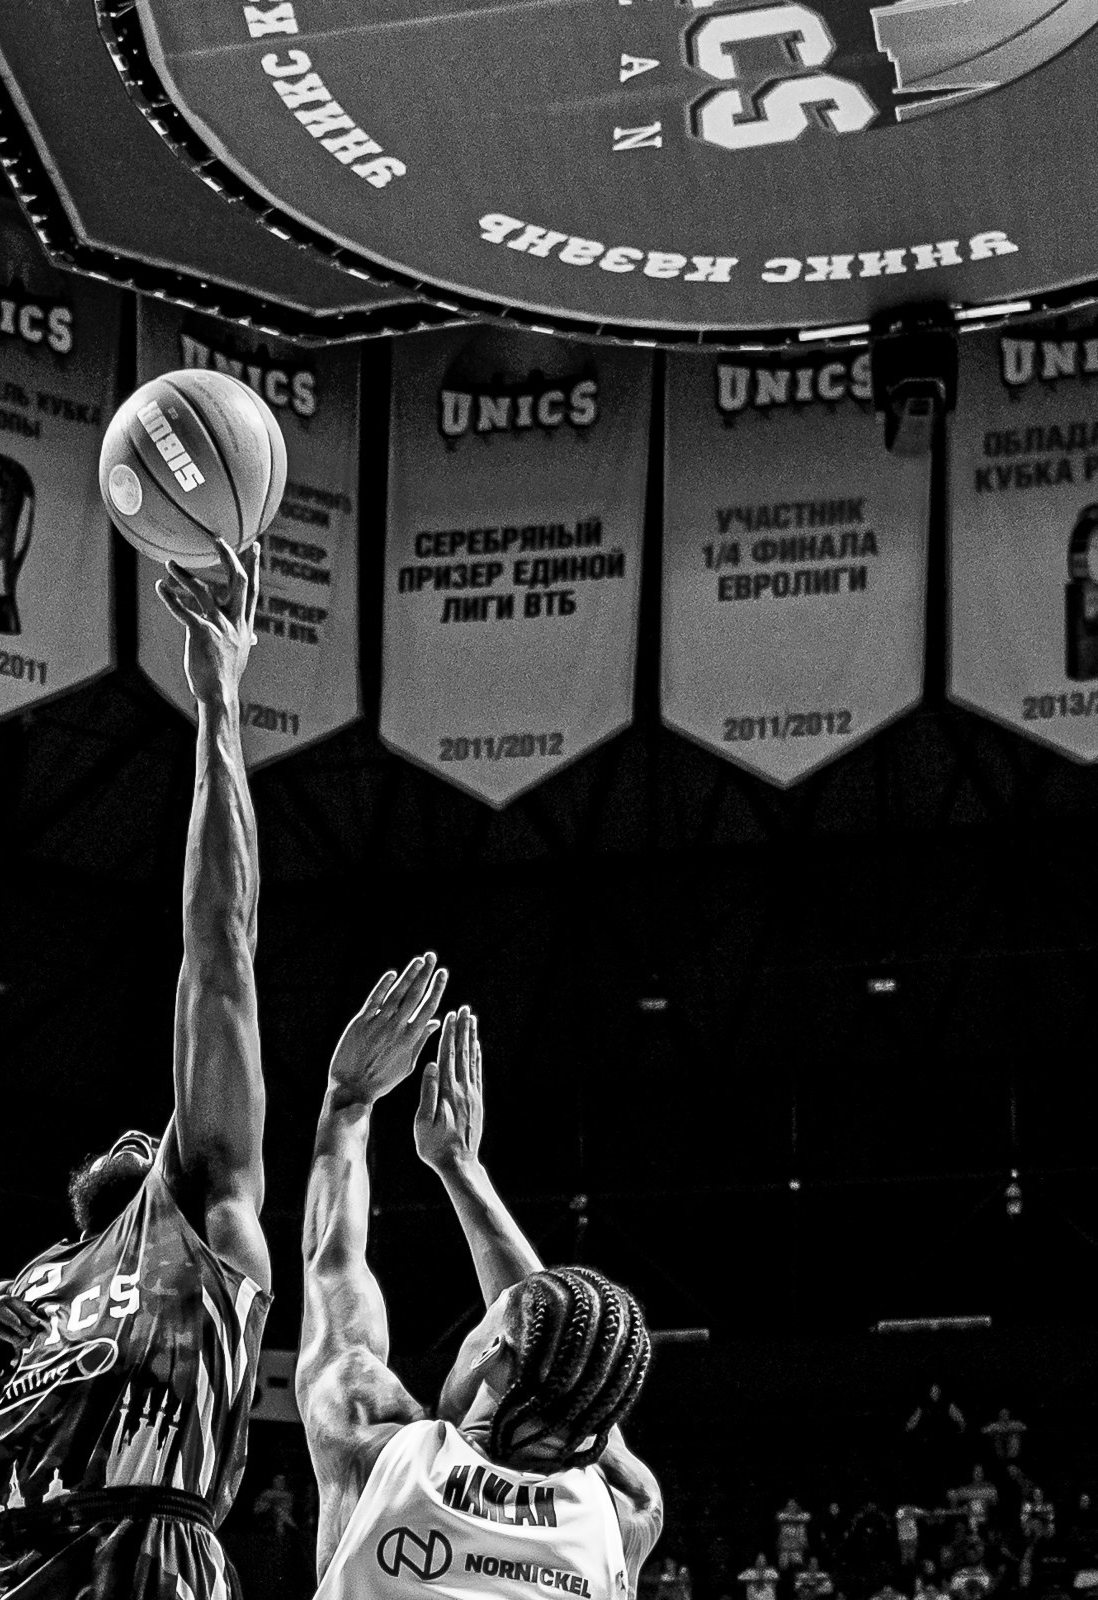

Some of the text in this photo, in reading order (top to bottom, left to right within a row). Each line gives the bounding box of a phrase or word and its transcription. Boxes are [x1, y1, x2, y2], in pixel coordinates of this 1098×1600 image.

[1002, 337, 1098, 385] UNI
[440, 380, 598, 436] UNICS
[975, 458, 1074, 493] КУБКА
[716, 499, 866, 534] УЧАСТНИК
[415, 515, 602, 559] СЕРЕБРЯНЫЙ
[702, 529, 879, 572] 1/4 ФИНАЛА
[398, 546, 625, 594] ПРИЗЕР ЕДИНОЙ
[718, 565, 869, 603] ЕВРОЛИГИ
[440, 589, 577, 624] ЛИГИ ВТБ
[722, 709, 853, 742] 2011/2012
[438, 731, 565, 763] 2011/2012
[465, 1552, 592, 1600] NORNICKEL
